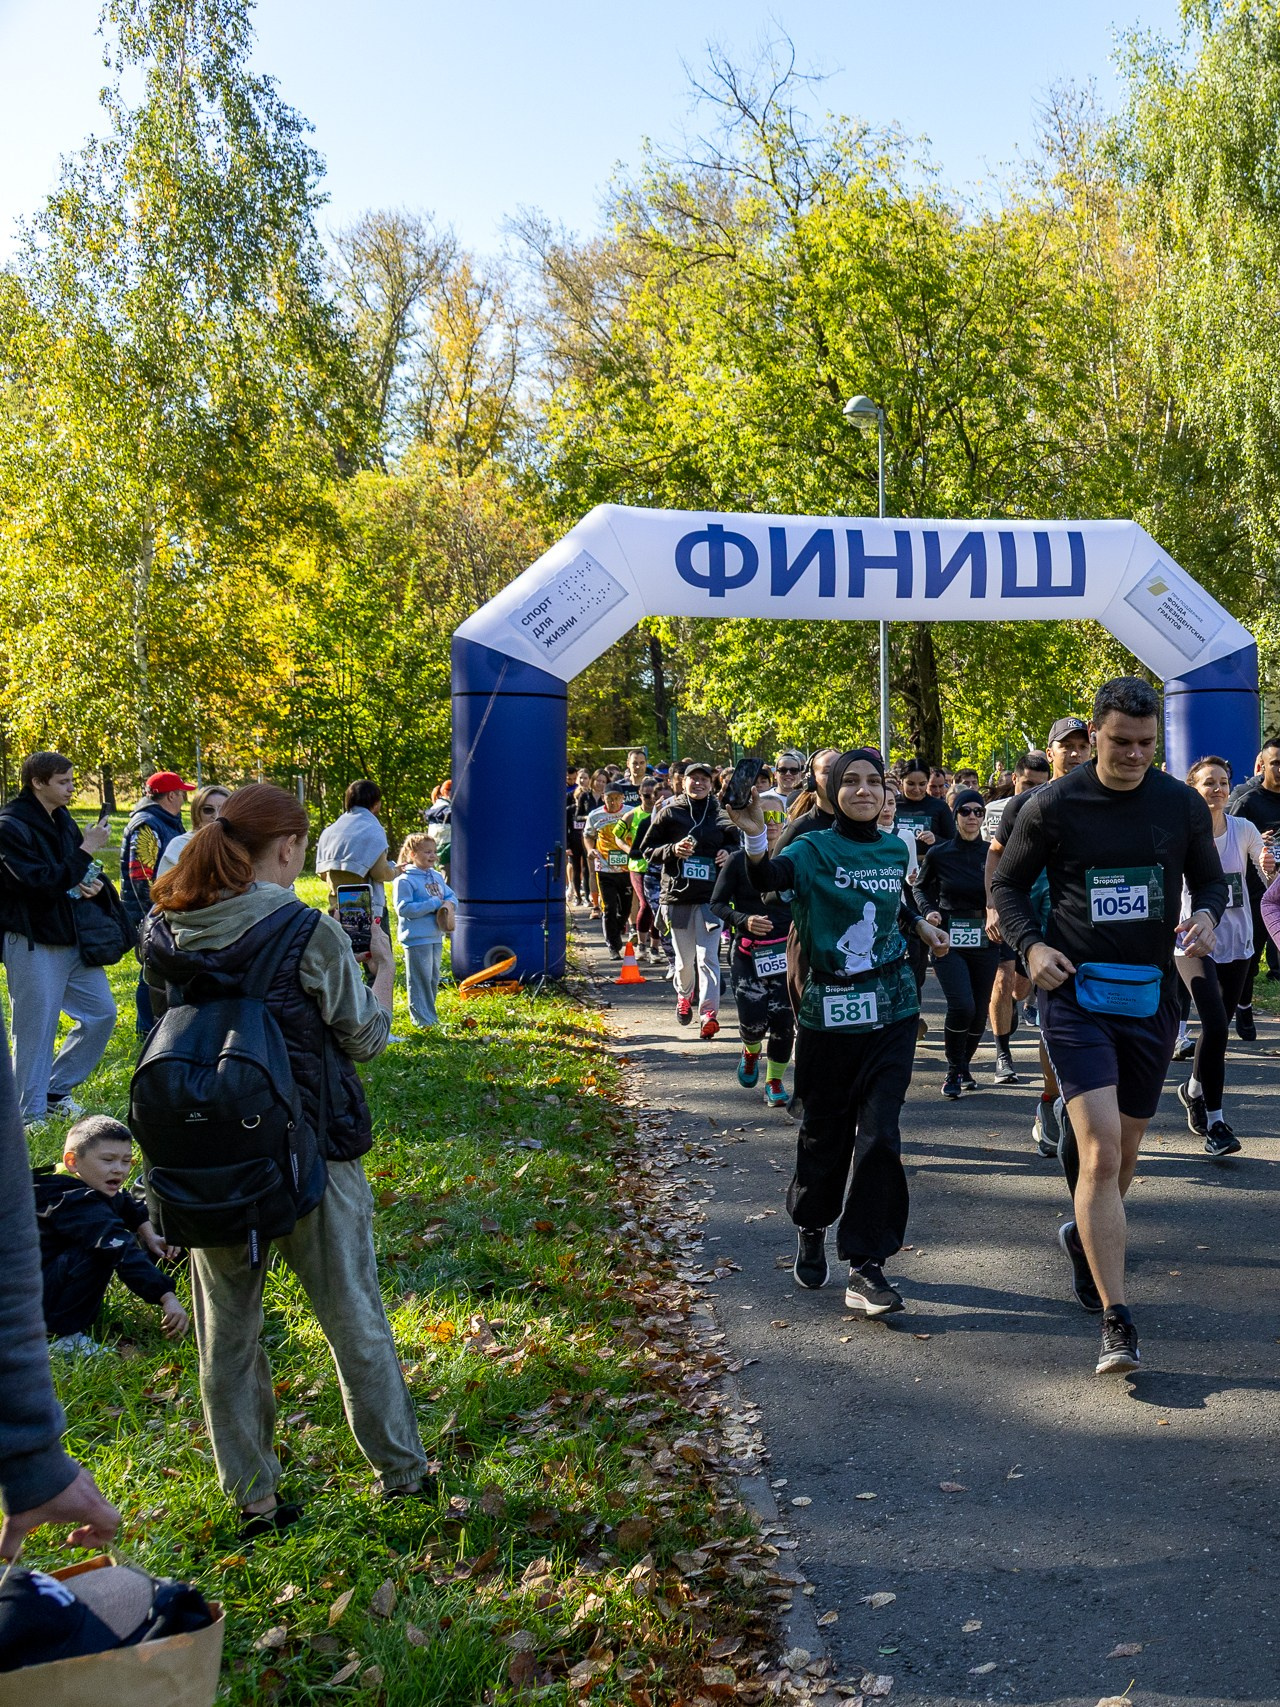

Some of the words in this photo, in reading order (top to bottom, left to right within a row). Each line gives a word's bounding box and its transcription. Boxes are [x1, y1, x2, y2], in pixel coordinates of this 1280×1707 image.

[675, 523, 1087, 599] ФИНИШ
[521, 596, 553, 627] спорт
[1167, 597, 1187, 617] ФОНДА
[532, 616, 554, 640] для
[1157, 607, 1183, 631] ГРАНТОВ
[1162, 602, 1206, 644] ПРЕЗИДЕНТСКИХ
[542, 616, 579, 649] жизни
[610, 856, 627, 864] 586
[686, 867, 707, 878] 610
[848, 869, 877, 879] серия
[1093, 895, 1147, 917] 1054
[952, 933, 979, 945] 525
[757, 958, 787, 974] 1055
[830, 1000, 872, 1023] 581
